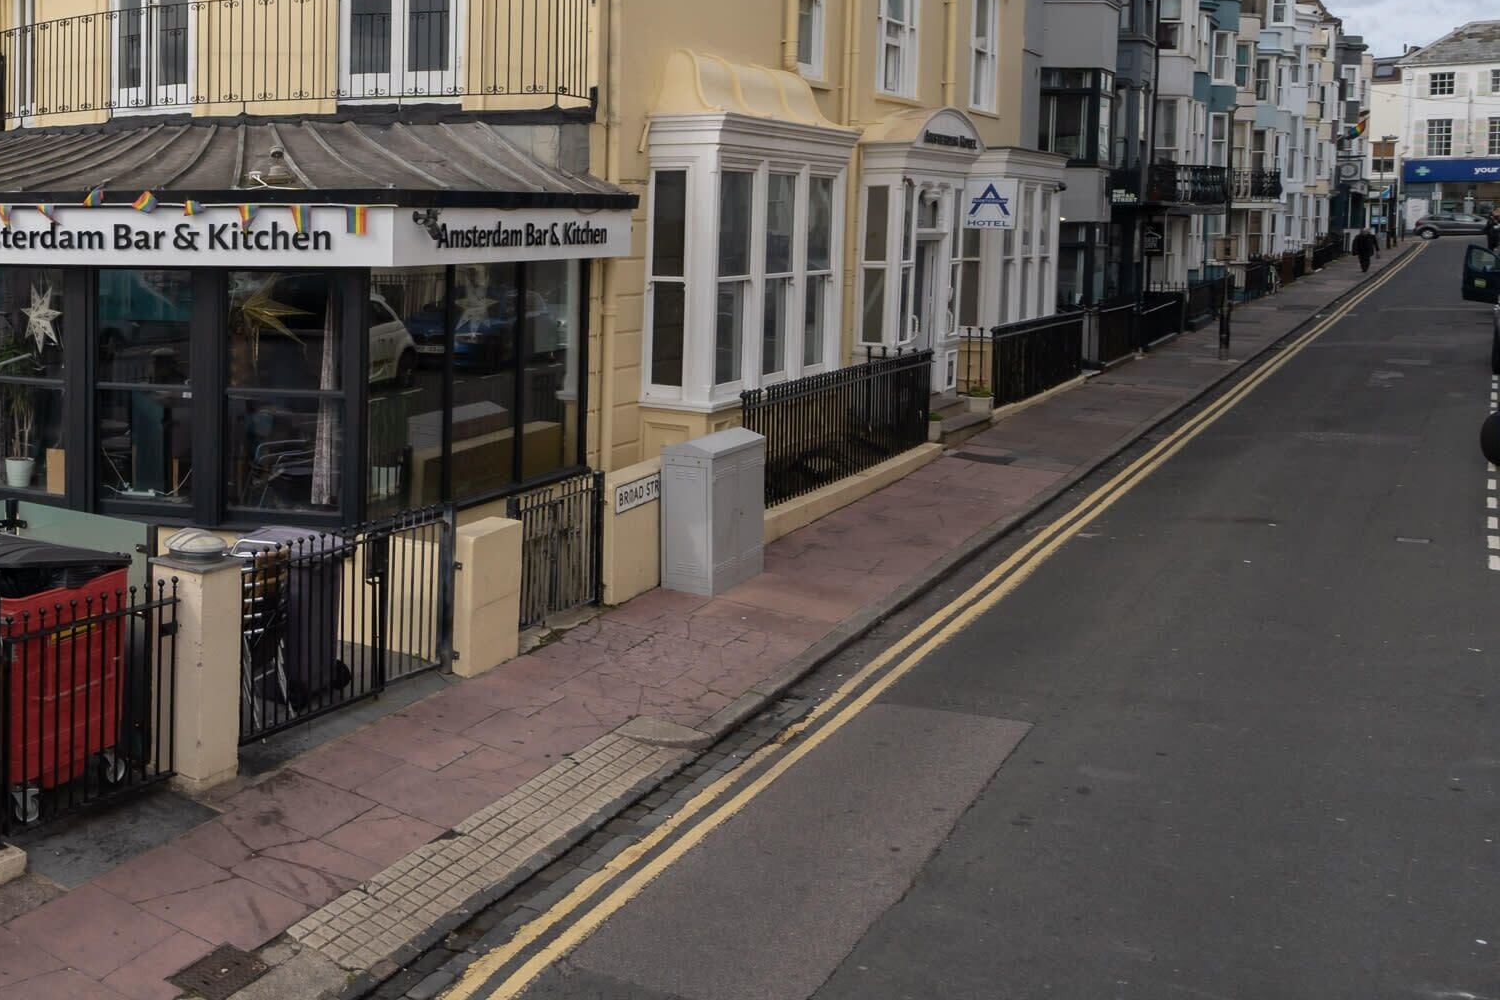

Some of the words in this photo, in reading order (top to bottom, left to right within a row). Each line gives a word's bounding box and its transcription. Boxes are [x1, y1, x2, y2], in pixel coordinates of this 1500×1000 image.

[1474, 166, 1500, 175] your
[113, 223, 165, 251] Bar
[172, 223, 200, 251] &
[208, 221, 332, 251] Kitchen
[437, 220, 523, 248] Amsterdam
[525, 223, 549, 246] Bar
[551, 222, 561, 246] &
[563, 220, 608, 245] Kitchen
